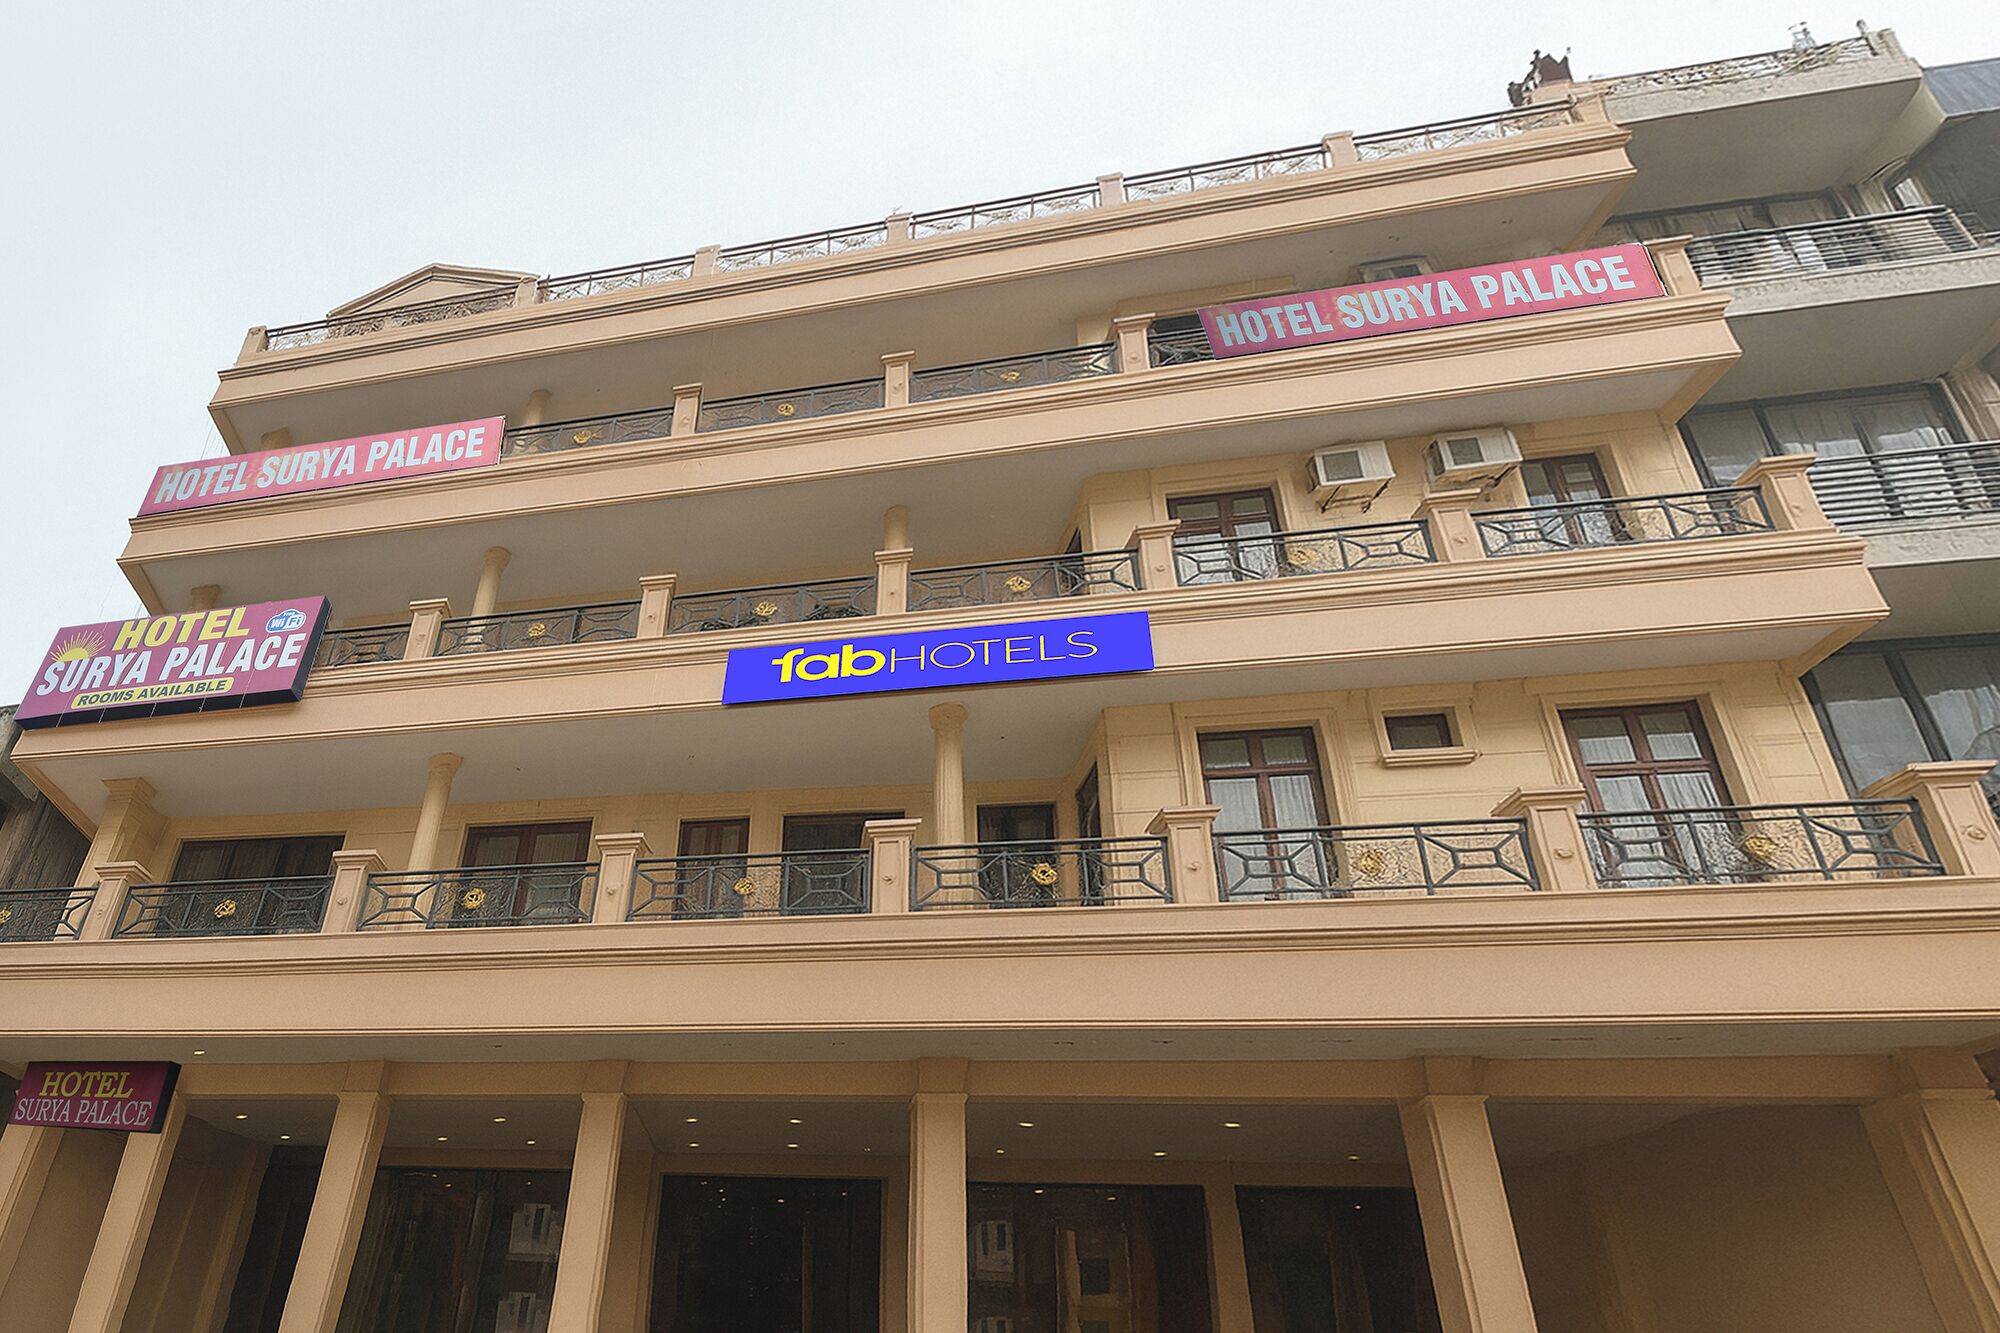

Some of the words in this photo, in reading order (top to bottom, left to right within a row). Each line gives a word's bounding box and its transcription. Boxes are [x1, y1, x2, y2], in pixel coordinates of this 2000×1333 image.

[1215, 302, 1333, 347] HOTEL
[1340, 280, 1467, 329] SURYA
[1470, 255, 1636, 309] PALACE
[154, 462, 247, 504] HOTEL
[256, 445, 355, 488] SURYA
[365, 426, 486, 472] PALACE
[111, 606, 250, 651] HOTEL
[36, 650, 152, 696] SURYA
[158, 632, 307, 681] PALACE
[77, 689, 134, 707] ROOMS
[137, 679, 228, 700] AVAILABLE
[39, 1071, 133, 1098] HOTEL
[15, 1098, 71, 1122] SURYA
[74, 1100, 152, 1126] PALACE
